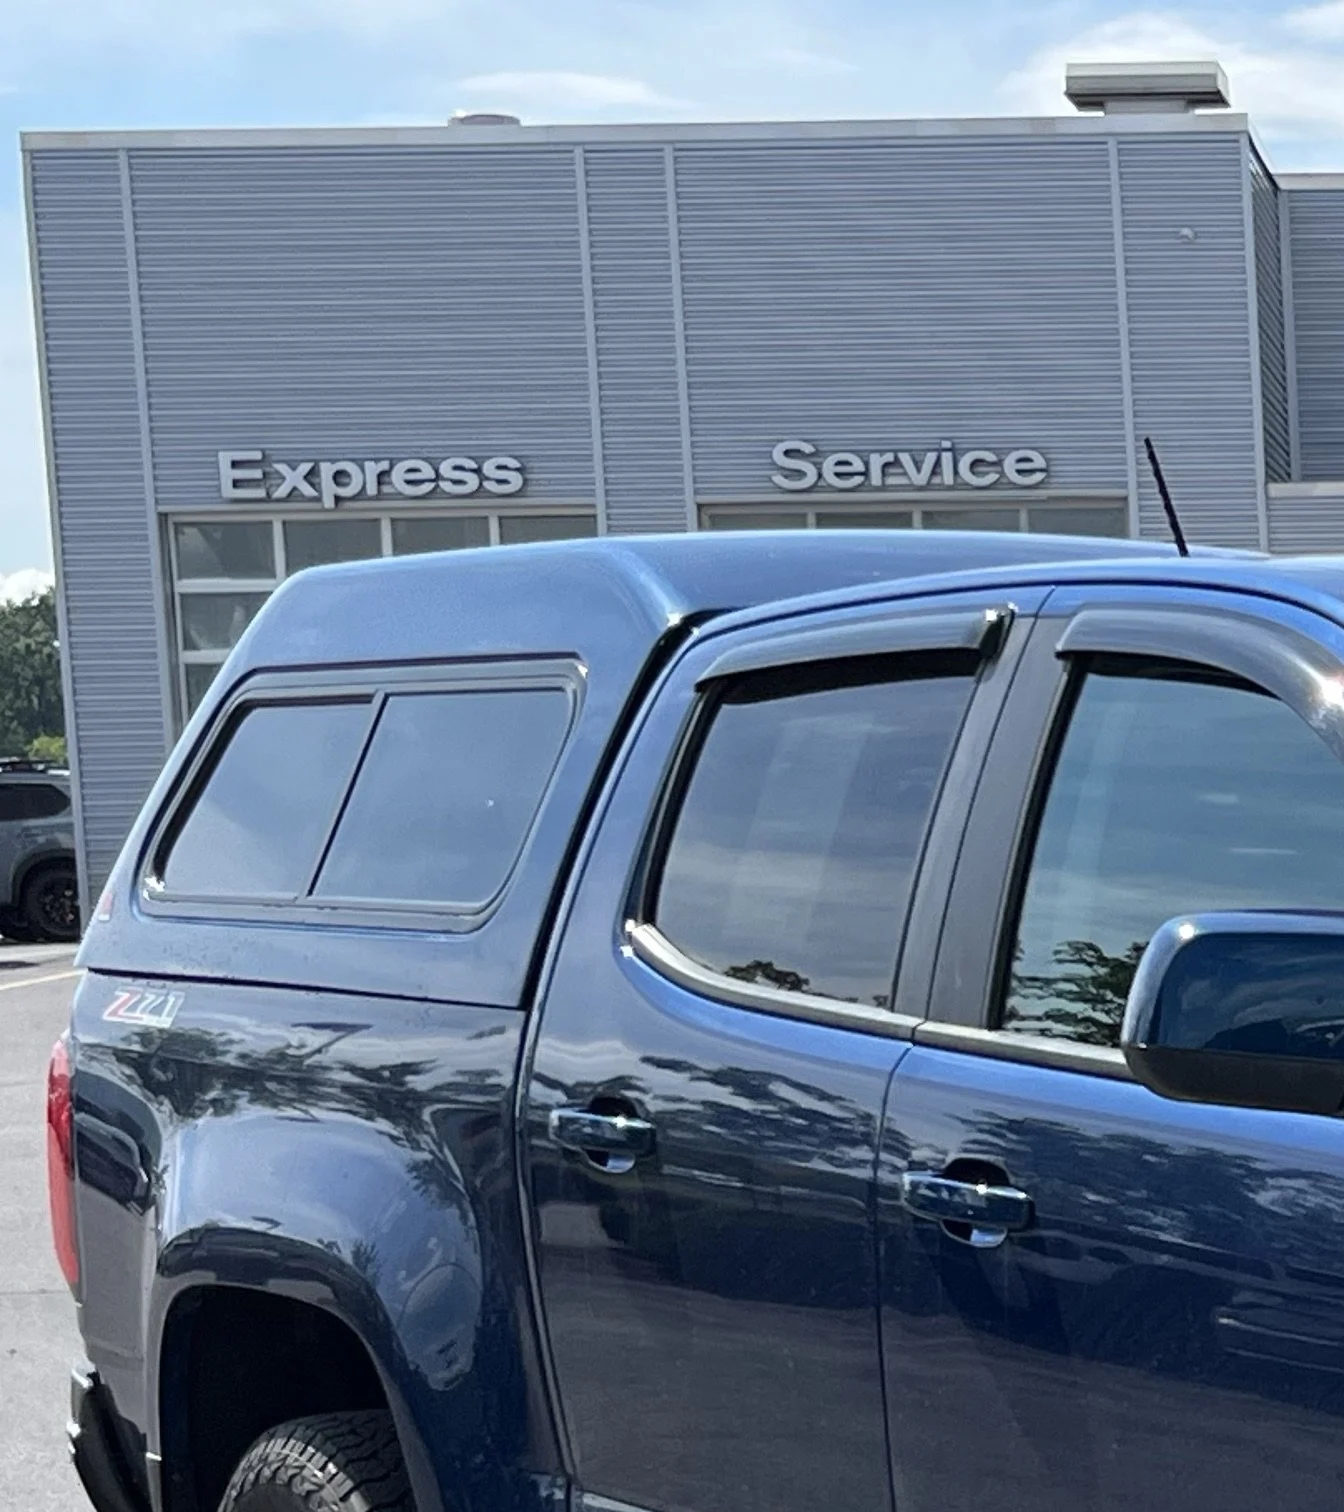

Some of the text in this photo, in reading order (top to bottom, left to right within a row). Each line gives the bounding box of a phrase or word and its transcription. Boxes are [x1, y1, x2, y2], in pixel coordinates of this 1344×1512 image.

[217, 449, 525, 509] Express
[770, 440, 1049, 491] Service
[102, 986, 186, 1029] Z71
